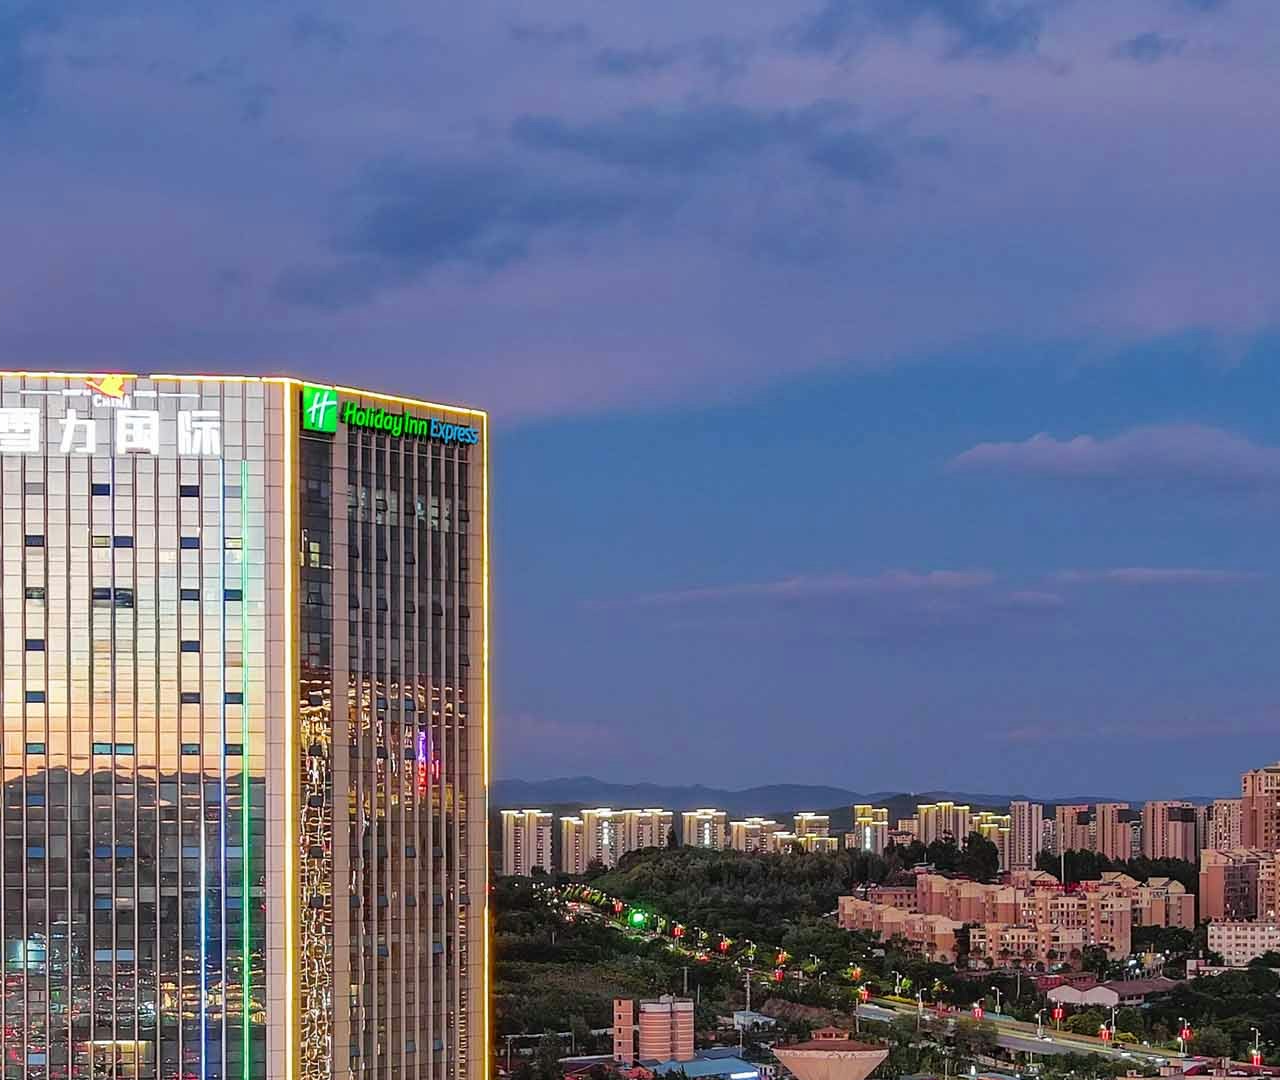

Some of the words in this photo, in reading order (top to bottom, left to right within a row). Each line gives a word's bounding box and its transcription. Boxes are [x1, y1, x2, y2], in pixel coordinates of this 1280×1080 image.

[343, 401, 404, 437] Holiday
[405, 411, 427, 435] Inn
[430, 417, 481, 445] Express
